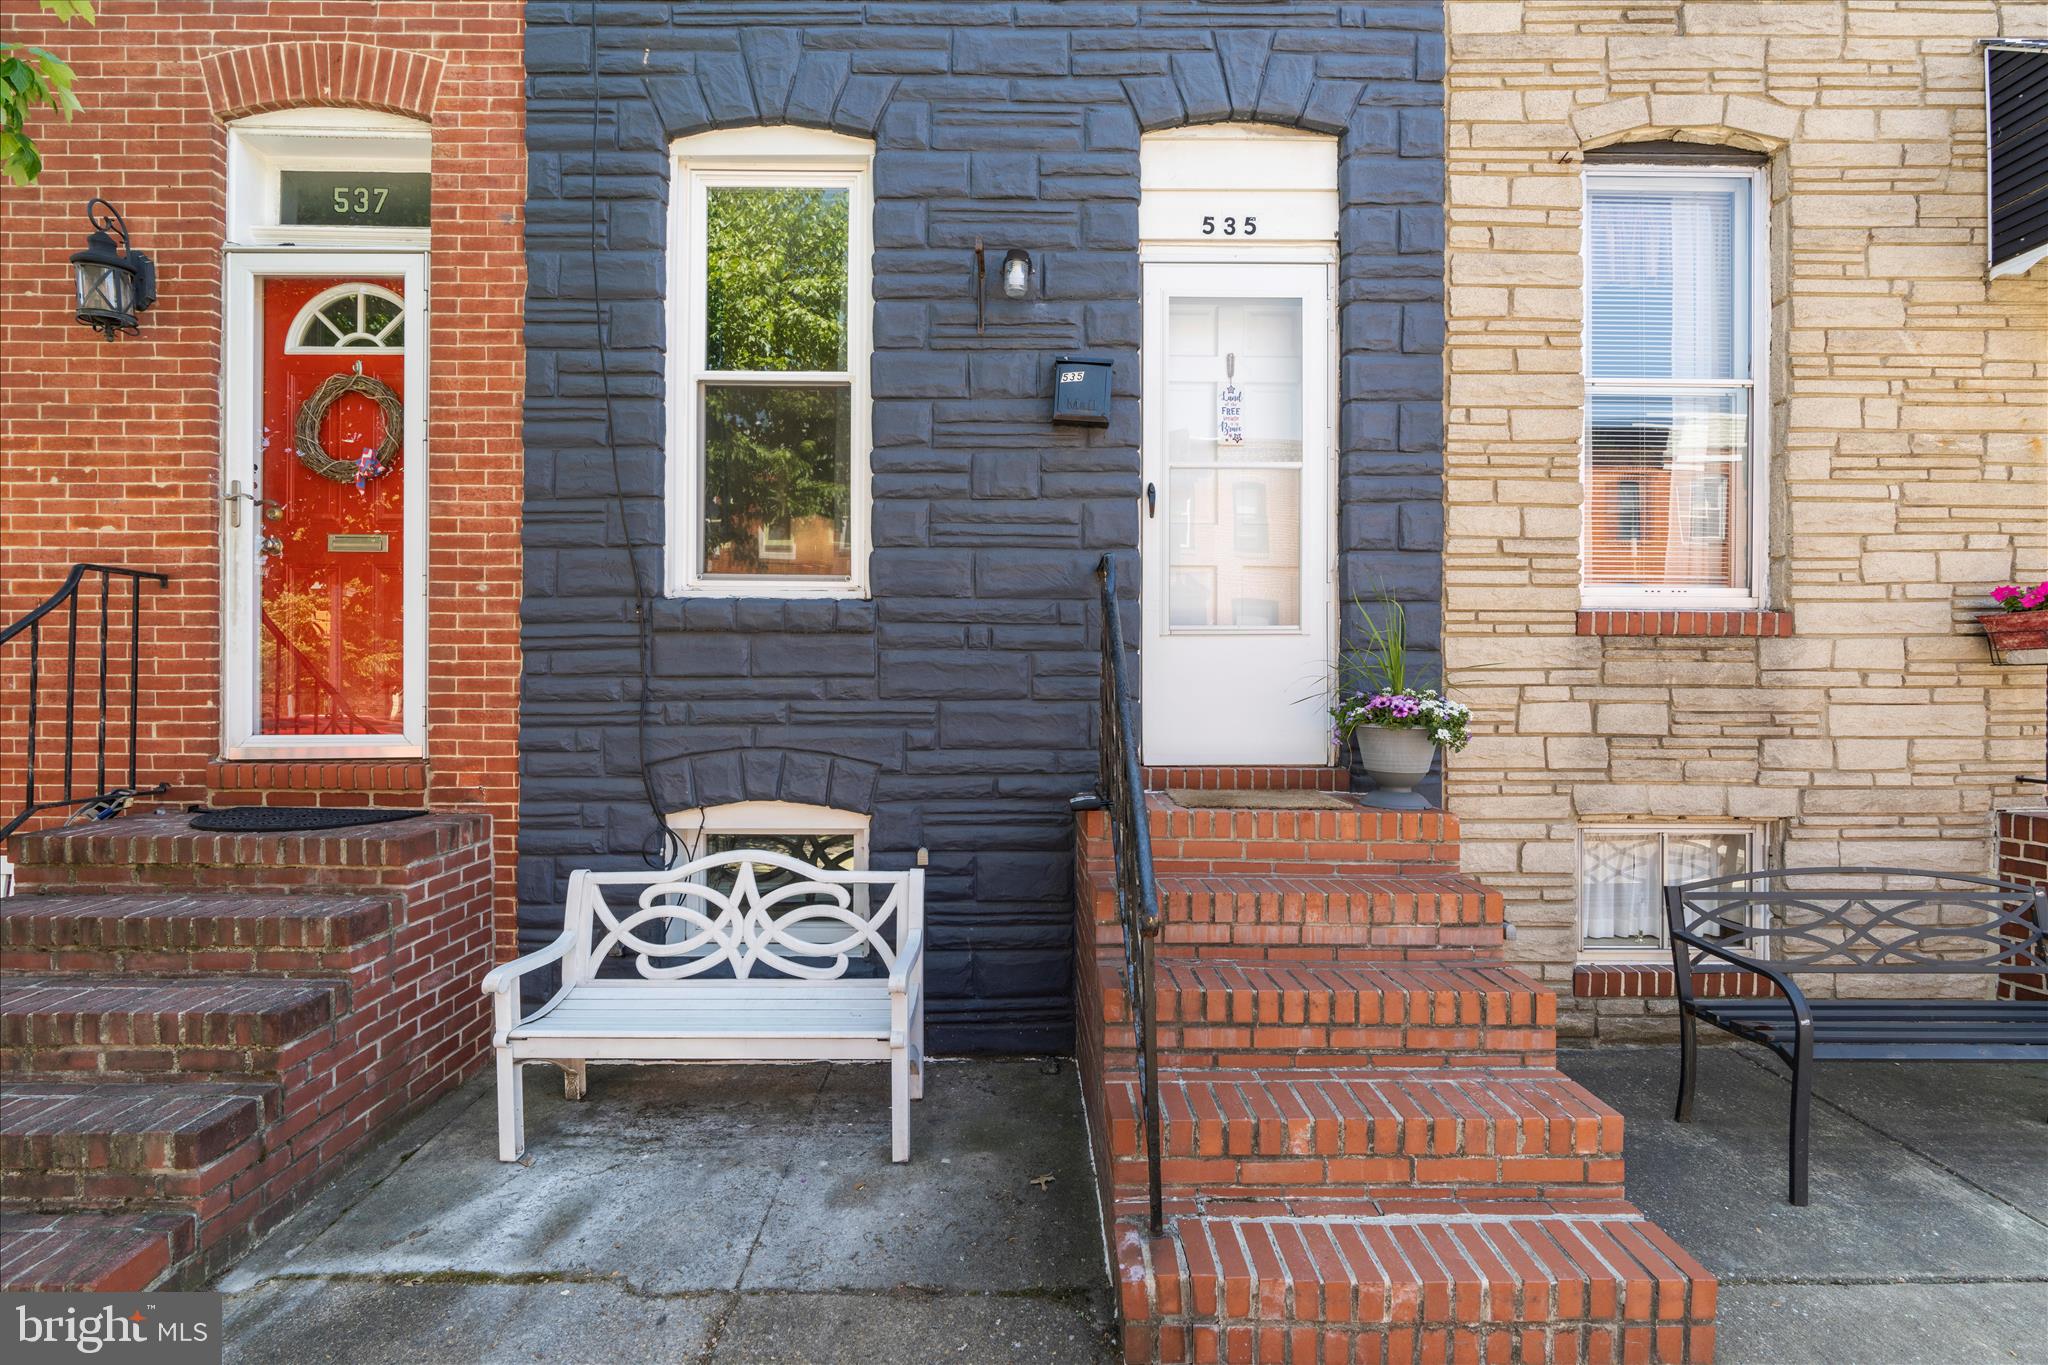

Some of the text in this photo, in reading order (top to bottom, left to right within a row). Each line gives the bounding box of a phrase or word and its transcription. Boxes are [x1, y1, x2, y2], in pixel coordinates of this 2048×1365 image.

[333, 187, 389, 213] 537
[1202, 216, 1257, 235] 535
[1062, 372, 1083, 382] 535
[1221, 407, 1241, 415] FREE
